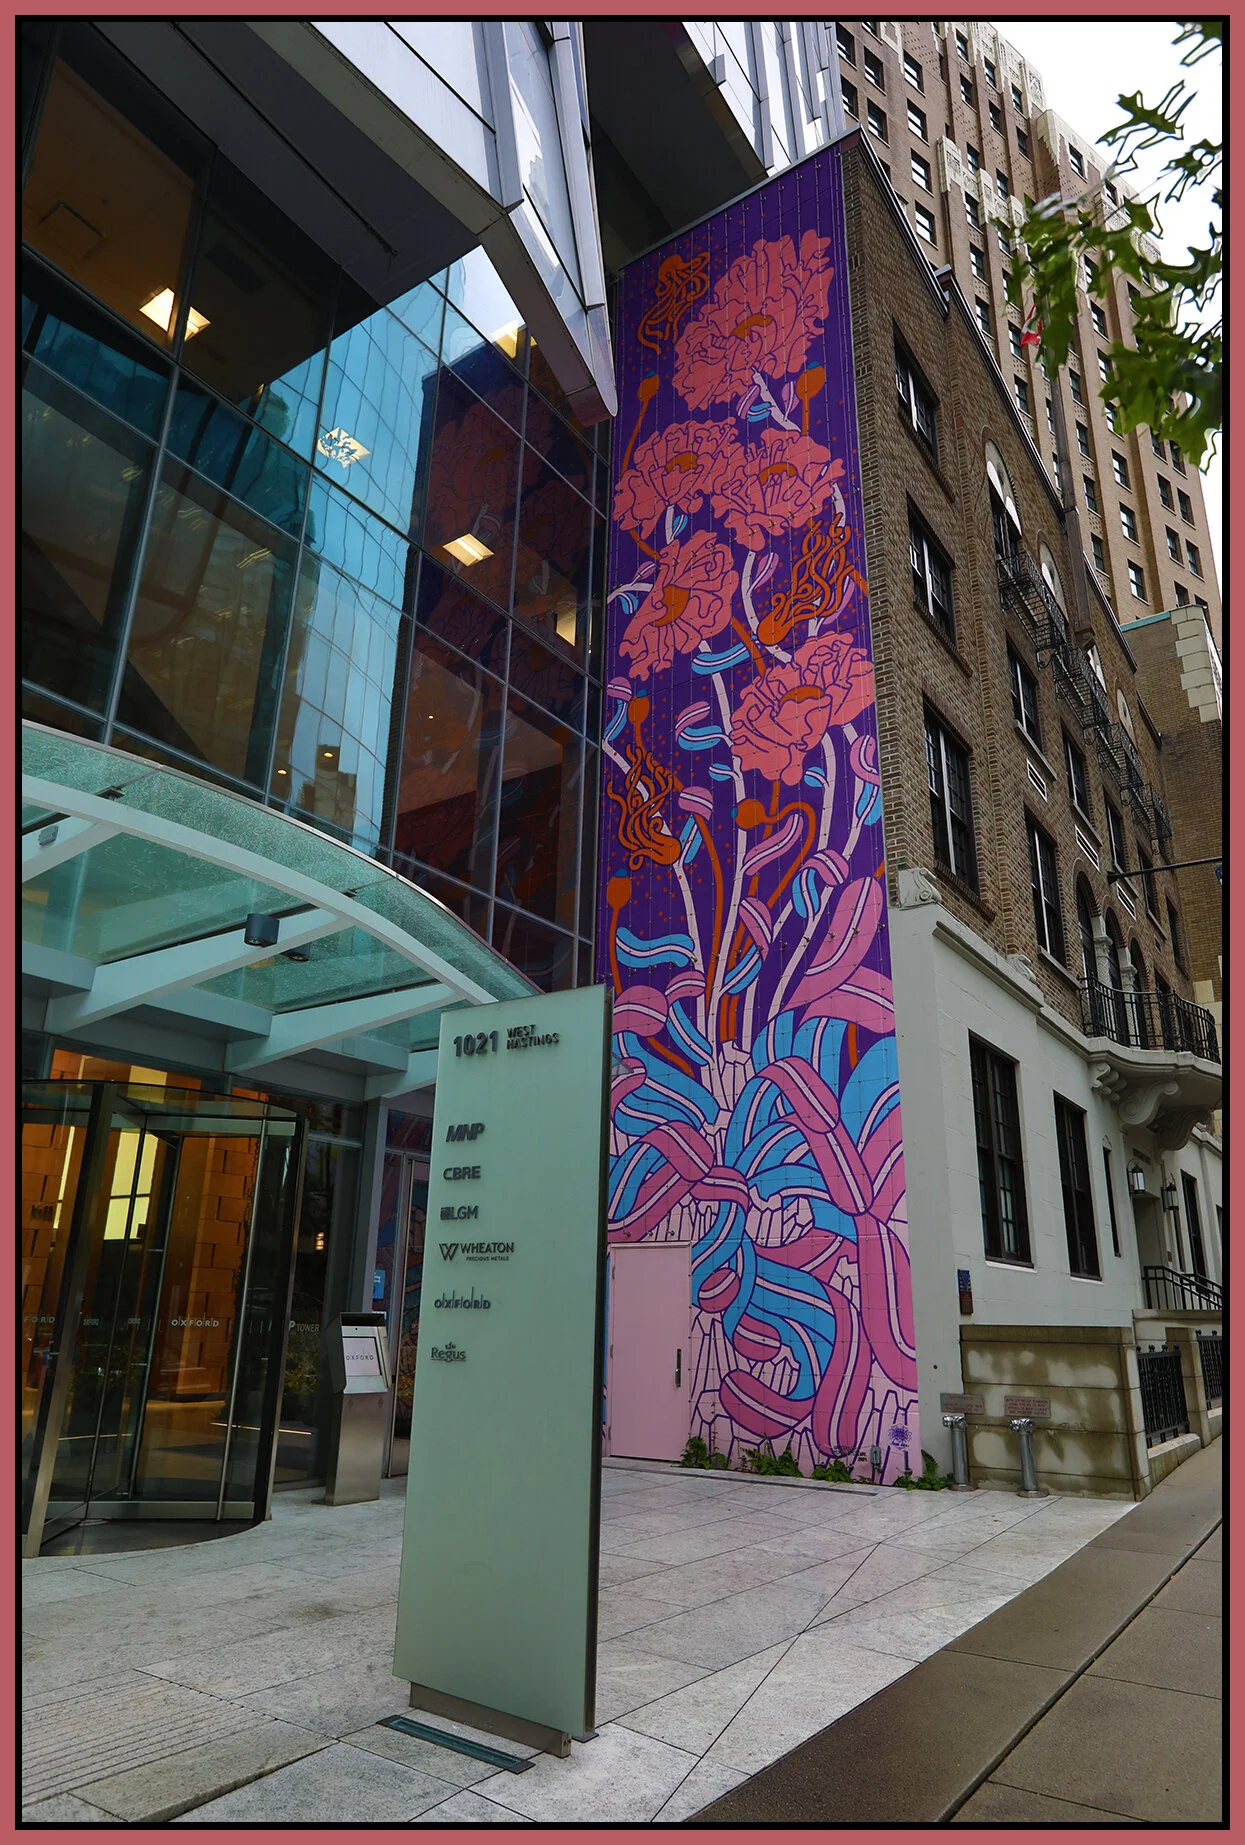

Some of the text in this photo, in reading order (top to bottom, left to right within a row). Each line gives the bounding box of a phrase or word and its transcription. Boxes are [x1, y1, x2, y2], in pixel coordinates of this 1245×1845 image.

[506, 1024, 536, 1039] WEST
[453, 1030, 499, 1057] 1021
[506, 1032, 560, 1050] HASTINGS
[445, 1122, 486, 1143] MNP
[443, 1165, 481, 1181] CBRE
[460, 1242, 515, 1255] WHEATON
[433, 1294, 491, 1310] OXFORD
[171, 1317, 220, 1328] OXFORD
[296, 1322, 320, 1332] TOWER
[430, 1346, 467, 1363] Regus
